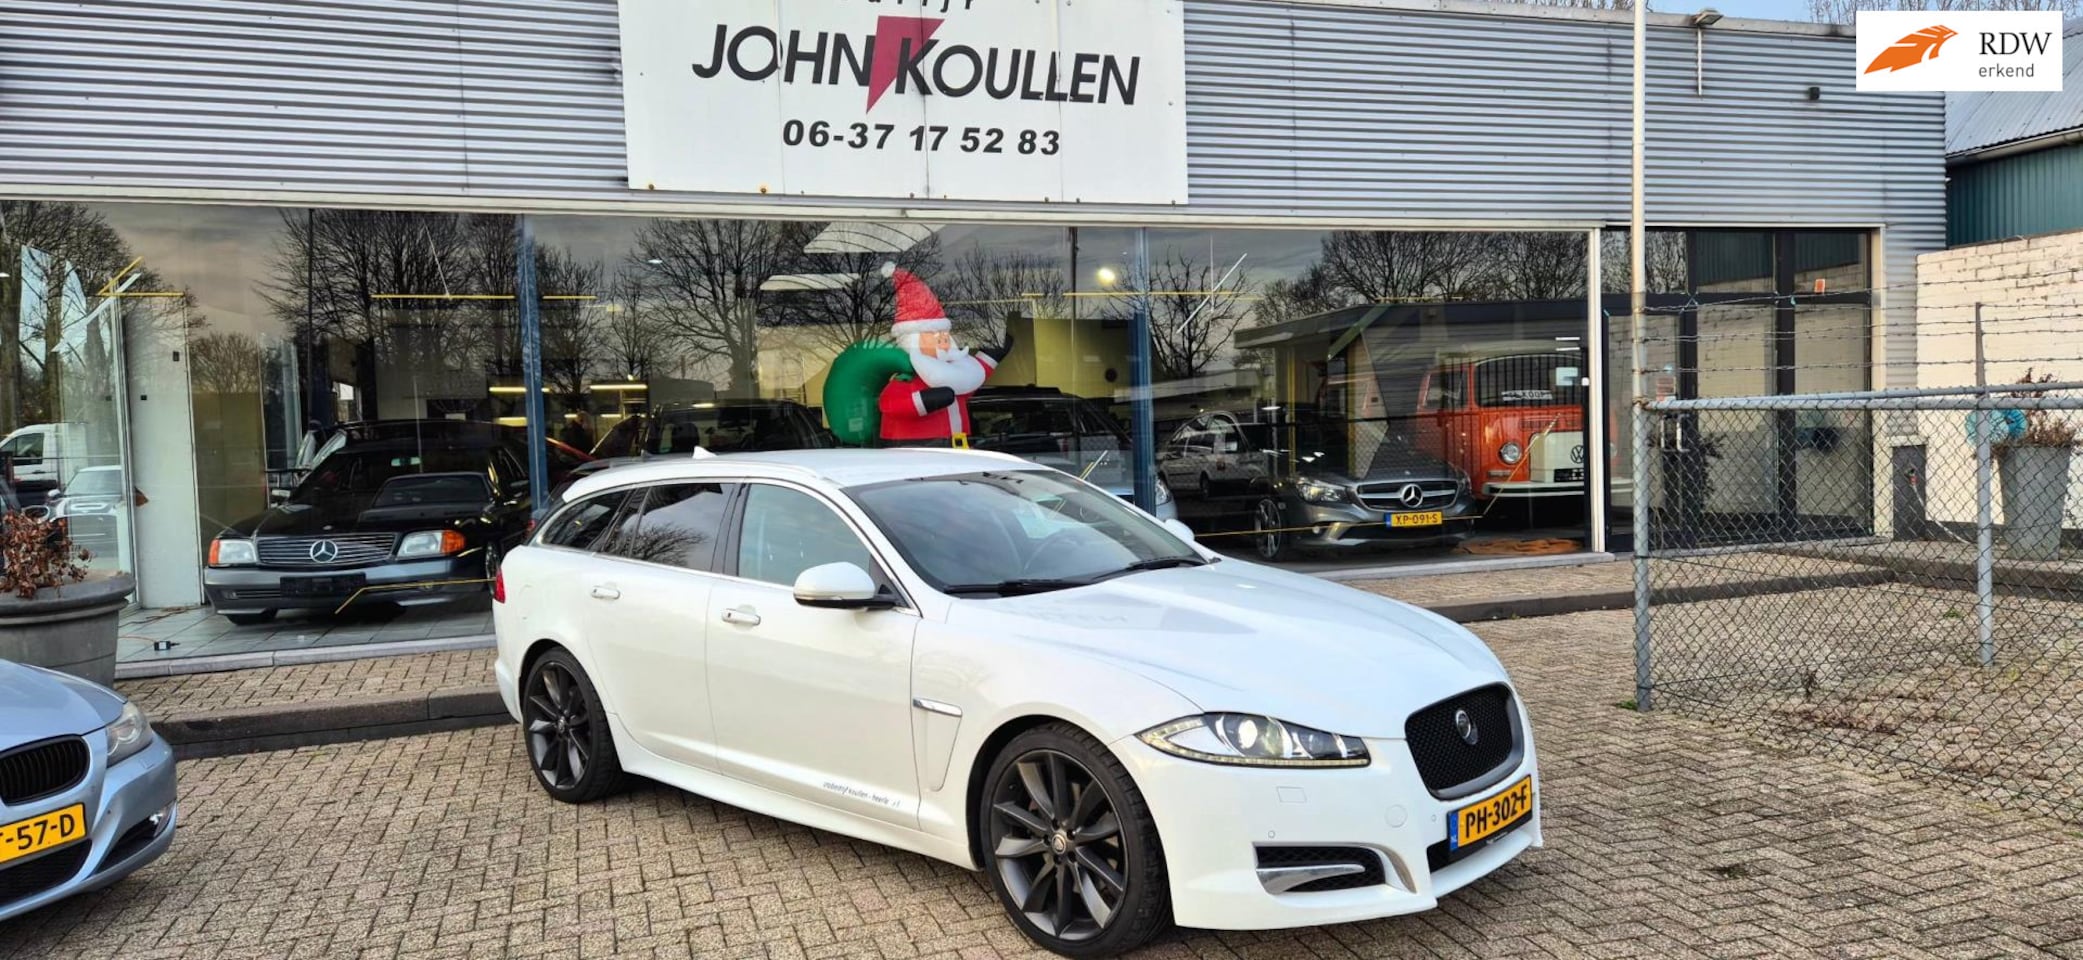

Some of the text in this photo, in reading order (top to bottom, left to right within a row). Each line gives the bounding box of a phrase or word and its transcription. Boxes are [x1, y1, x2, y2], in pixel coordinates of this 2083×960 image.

[692, 24, 1141, 105] JOHN KOULLEN
[782, 119, 1061, 155] 06-37 17 52 83
[0, 813, 75, 850] -57-D
[1465, 784, 1528, 838] PH-302-F
